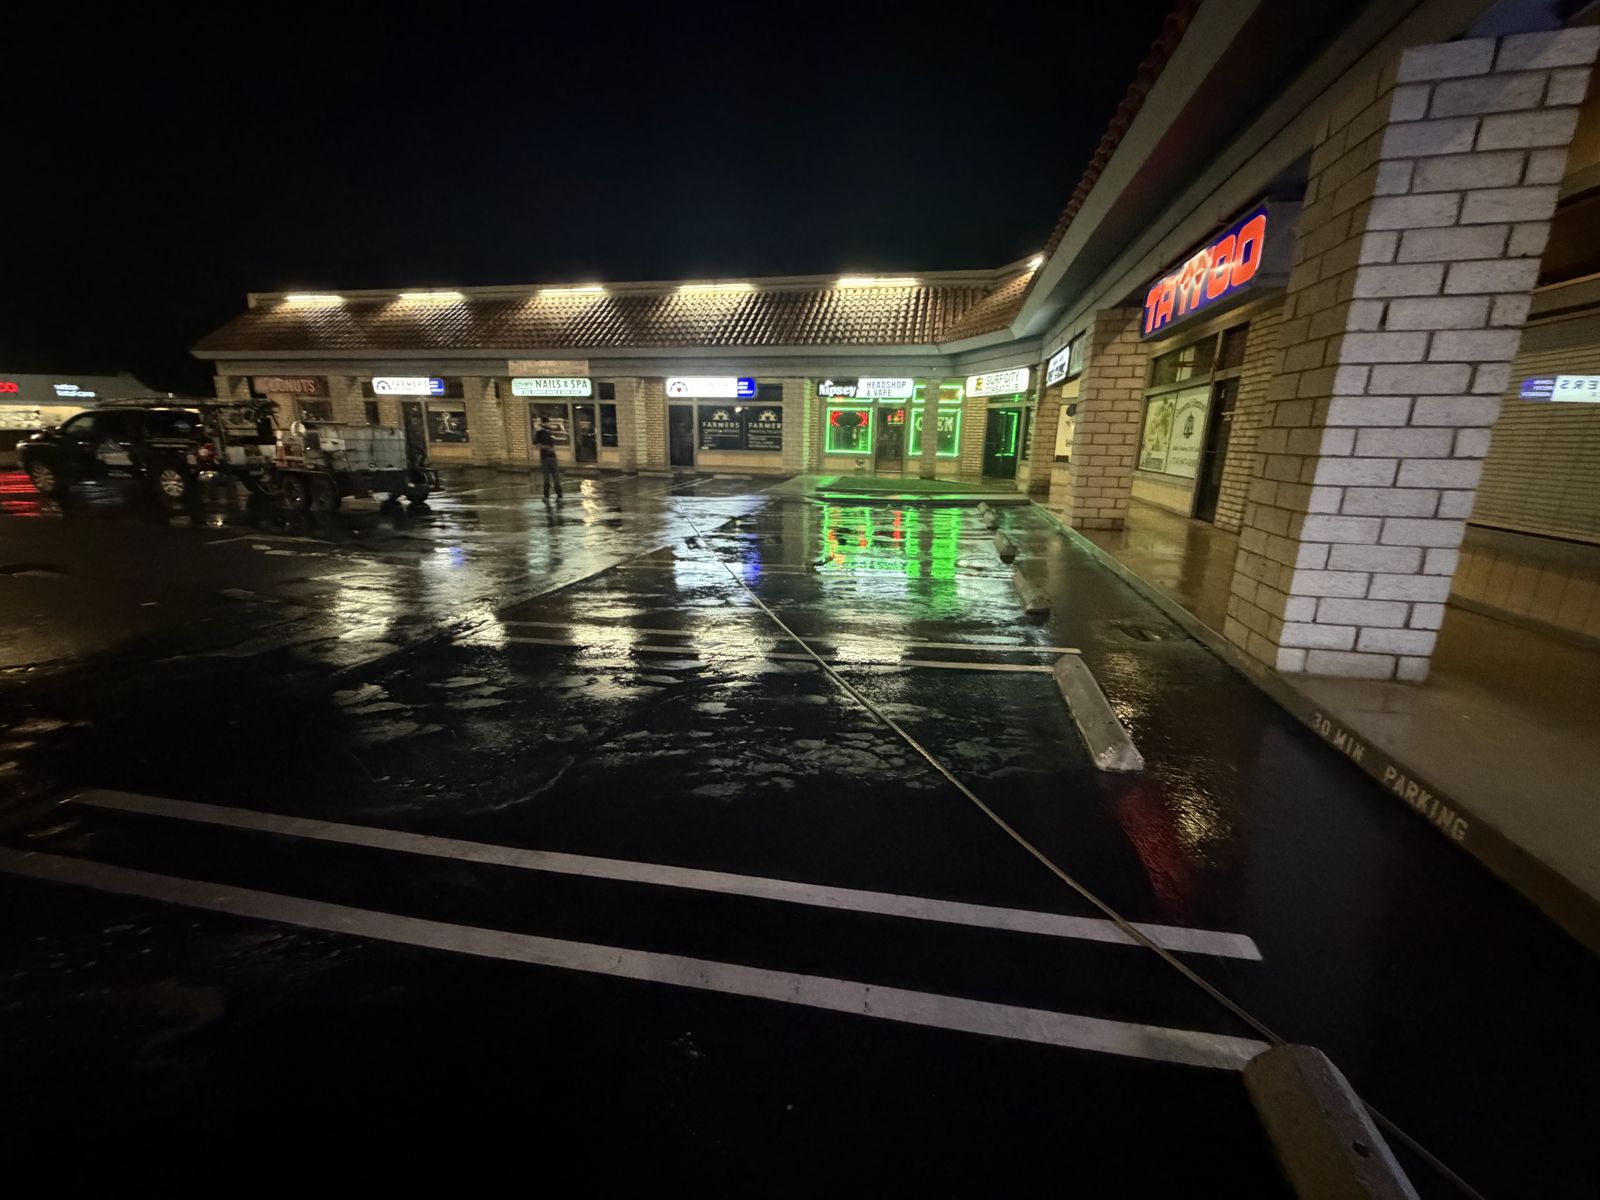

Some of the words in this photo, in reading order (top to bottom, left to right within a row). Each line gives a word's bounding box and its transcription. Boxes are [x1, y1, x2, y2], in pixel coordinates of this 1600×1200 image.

[1145, 214, 1267, 333] TATTOO
[985, 374, 1003, 386] SURF
[1004, 371, 1020, 383] CITY
[535, 379, 561, 389] NAILS
[570, 379, 588, 388] SPA
[866, 380, 907, 389] HEADSHOP
[873, 388, 892, 397] VAPE
[702, 421, 740, 429] FARMERS
[1312, 712, 1330, 737] 30
[1333, 728, 1366, 762] MIN
[1383, 765, 1469, 841] PARKING
